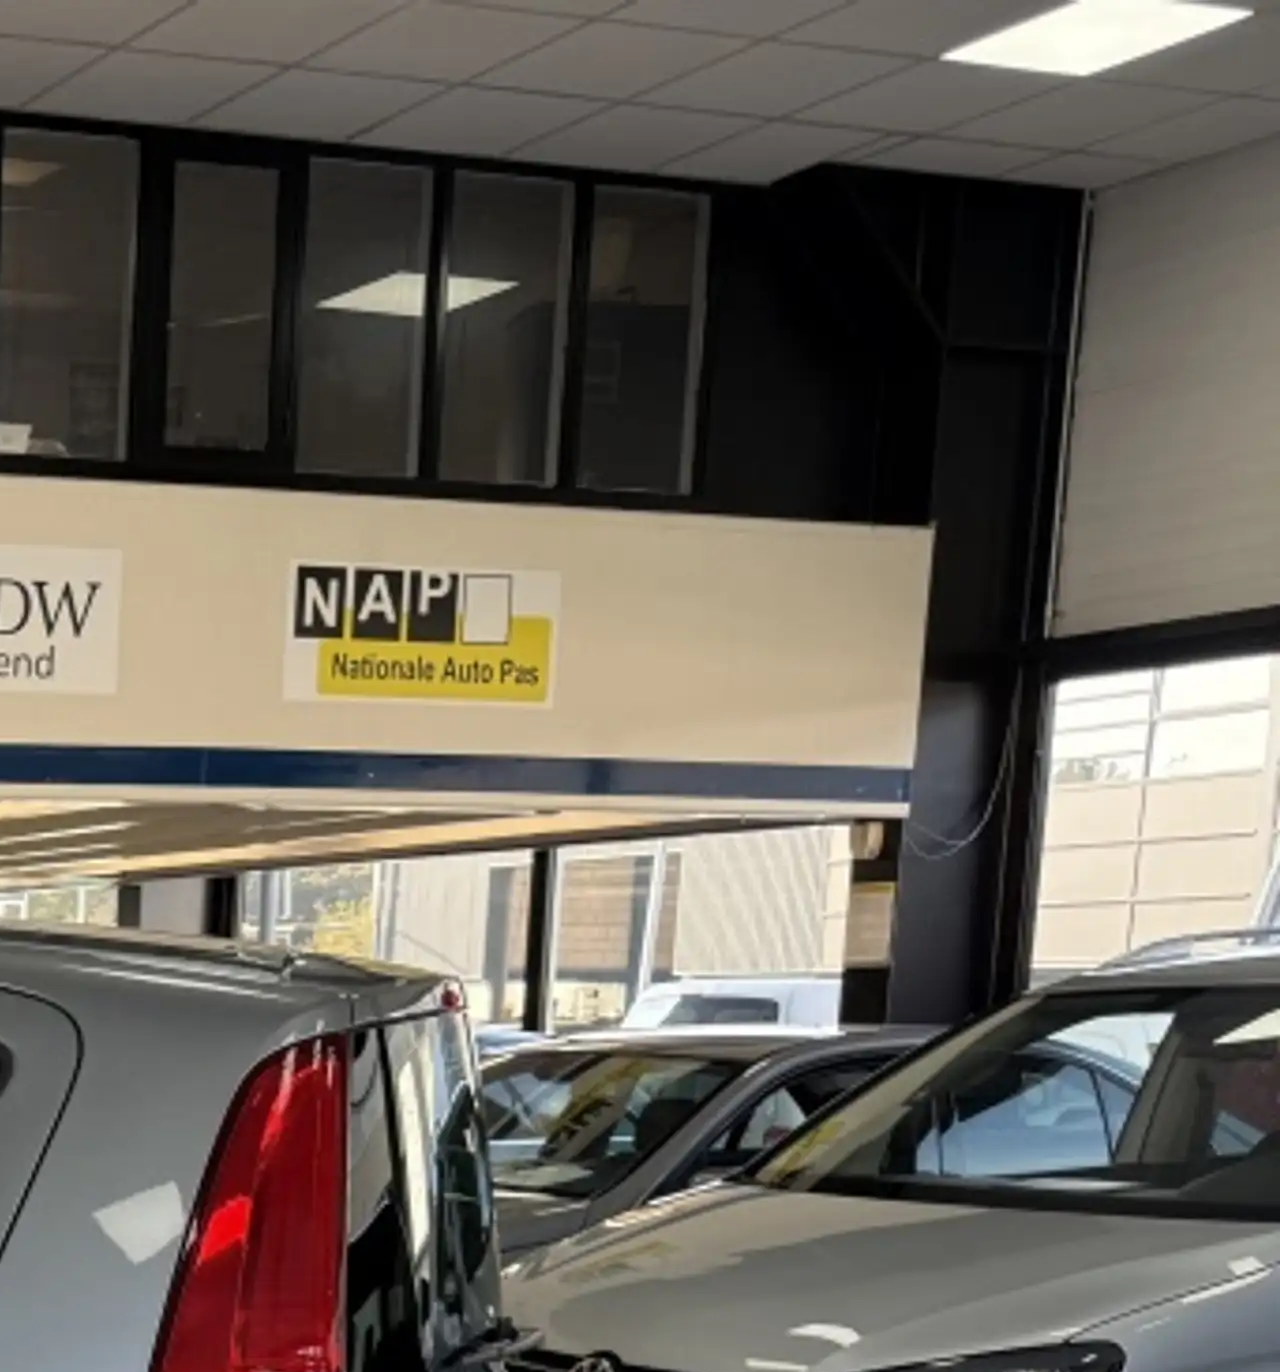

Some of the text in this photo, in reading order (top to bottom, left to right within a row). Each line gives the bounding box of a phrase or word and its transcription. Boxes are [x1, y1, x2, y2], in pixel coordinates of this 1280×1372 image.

[302, 572, 452, 629] NAP
[331, 652, 540, 687] Nationale Auto Pas
